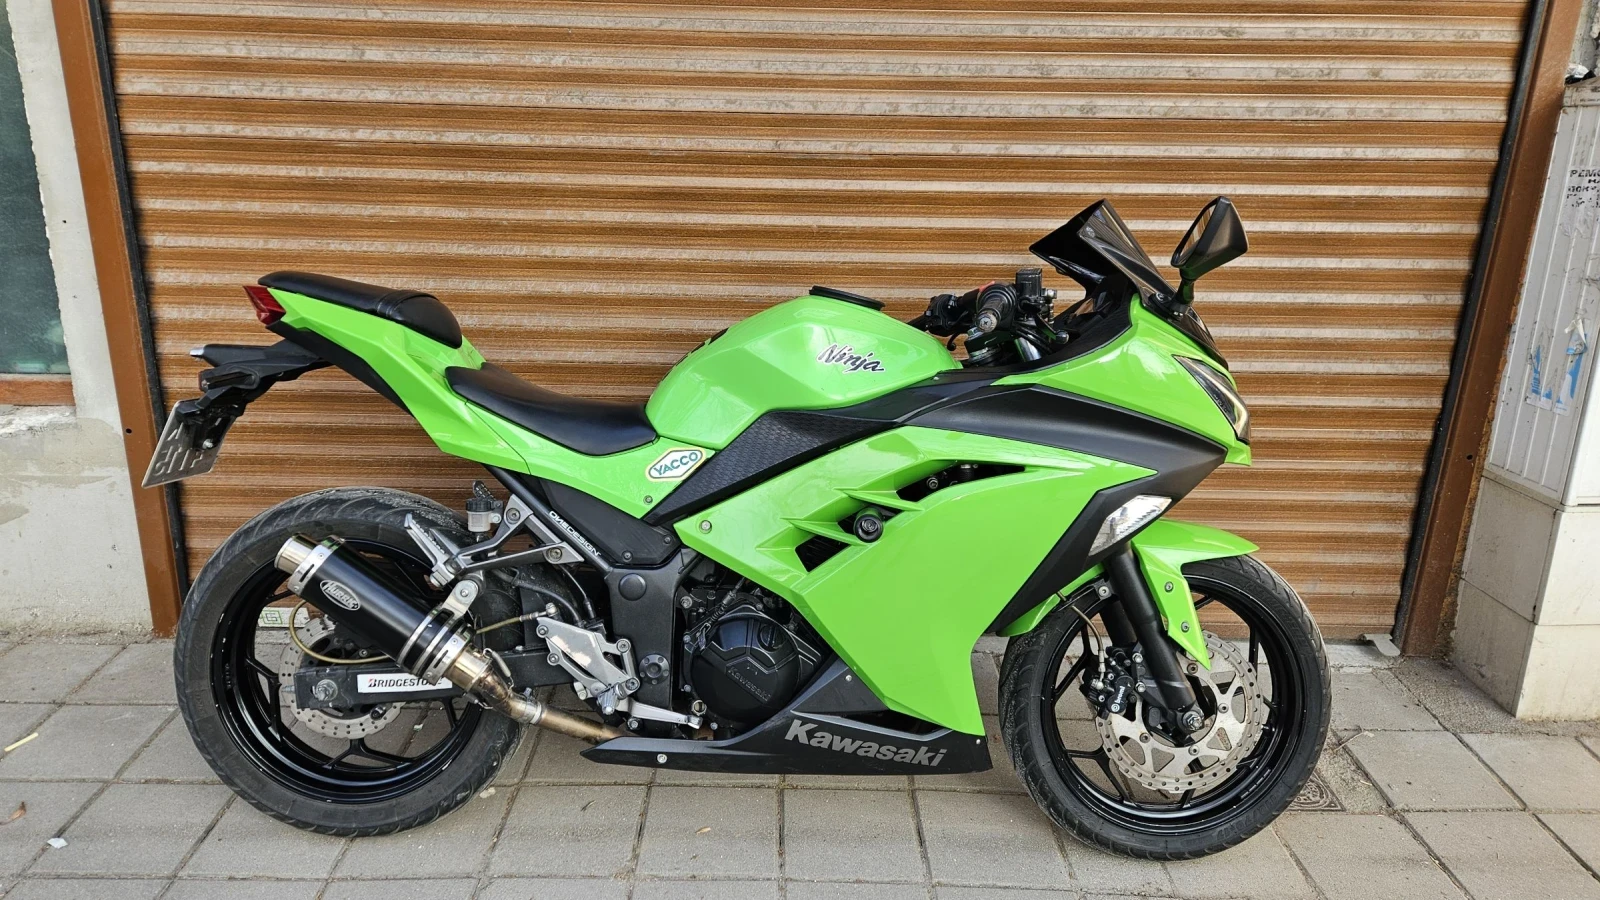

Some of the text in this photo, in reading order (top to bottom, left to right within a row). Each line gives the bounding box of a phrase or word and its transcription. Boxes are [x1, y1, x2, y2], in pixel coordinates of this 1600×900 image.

[817, 344, 885, 373] Ninja
[653, 451, 699, 477] YACCO
[368, 678, 442, 688] BRIDGESTO
[728, 666, 772, 702] Kawasaki
[784, 718, 948, 768] Kawasaki
